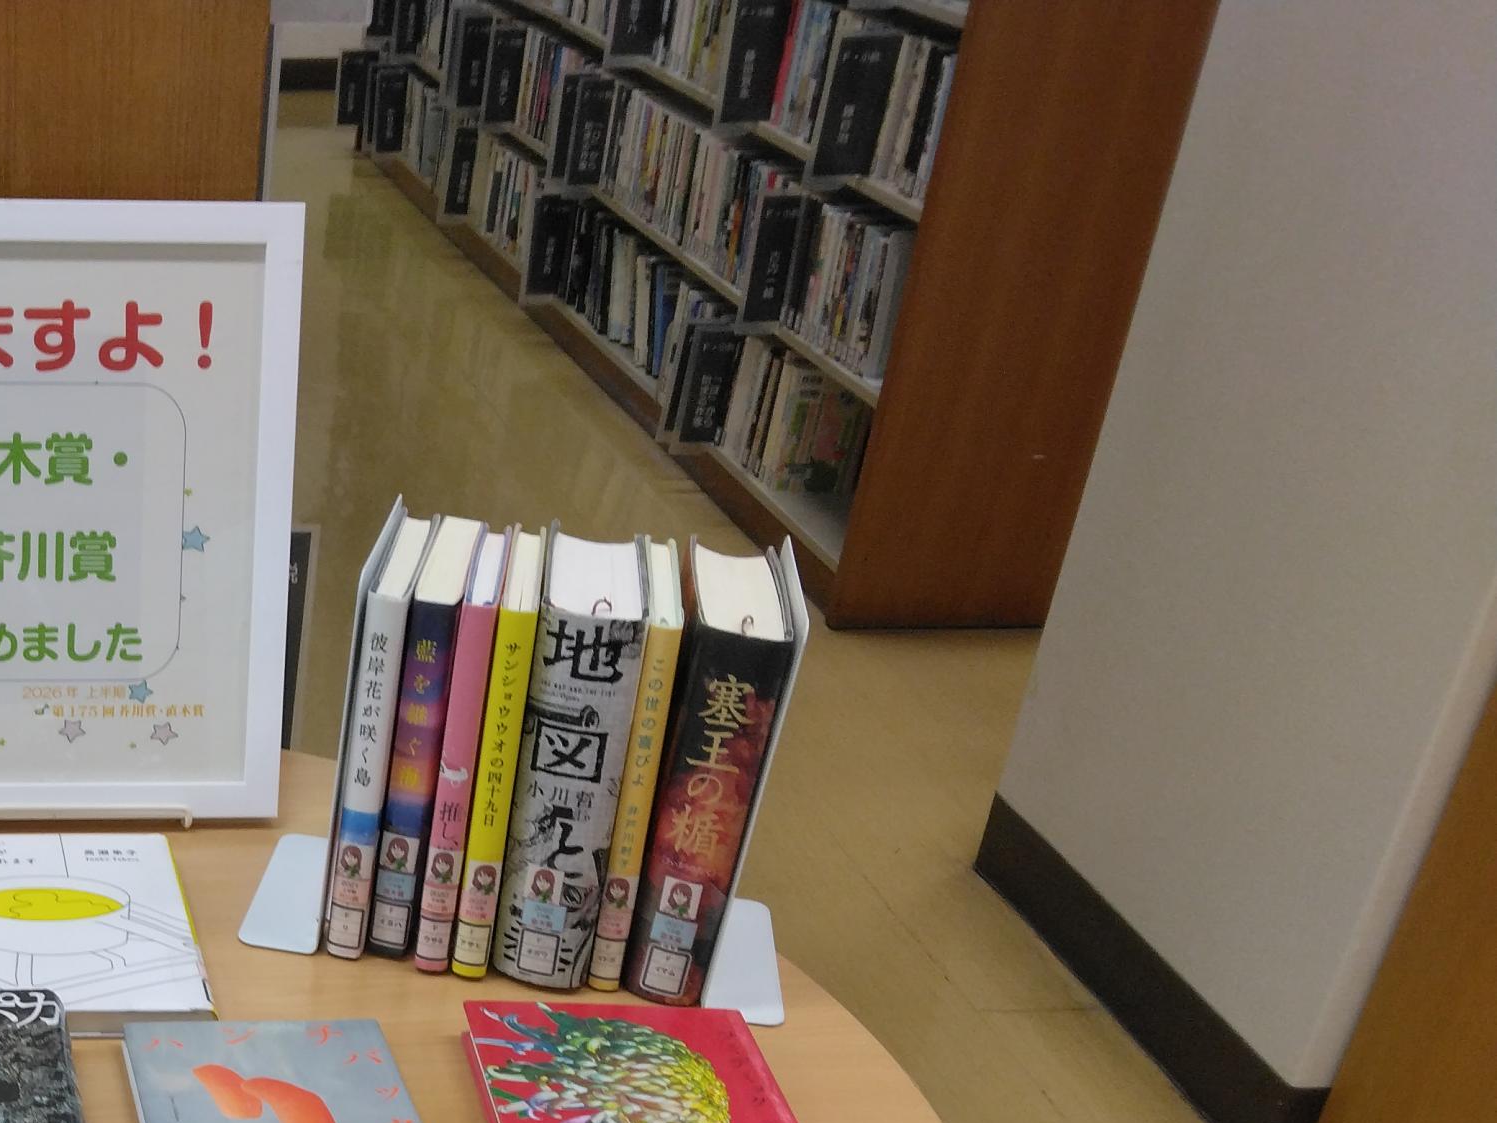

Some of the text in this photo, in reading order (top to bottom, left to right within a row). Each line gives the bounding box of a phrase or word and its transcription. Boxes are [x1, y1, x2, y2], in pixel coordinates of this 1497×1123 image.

[353, 632, 388, 787] 彼岸花が咲く島
[483, 642, 521, 827] サンショウウオの四十九日
[632, 659, 665, 787] この世の喜びよ
[666, 674, 755, 857] 塞王の楯
